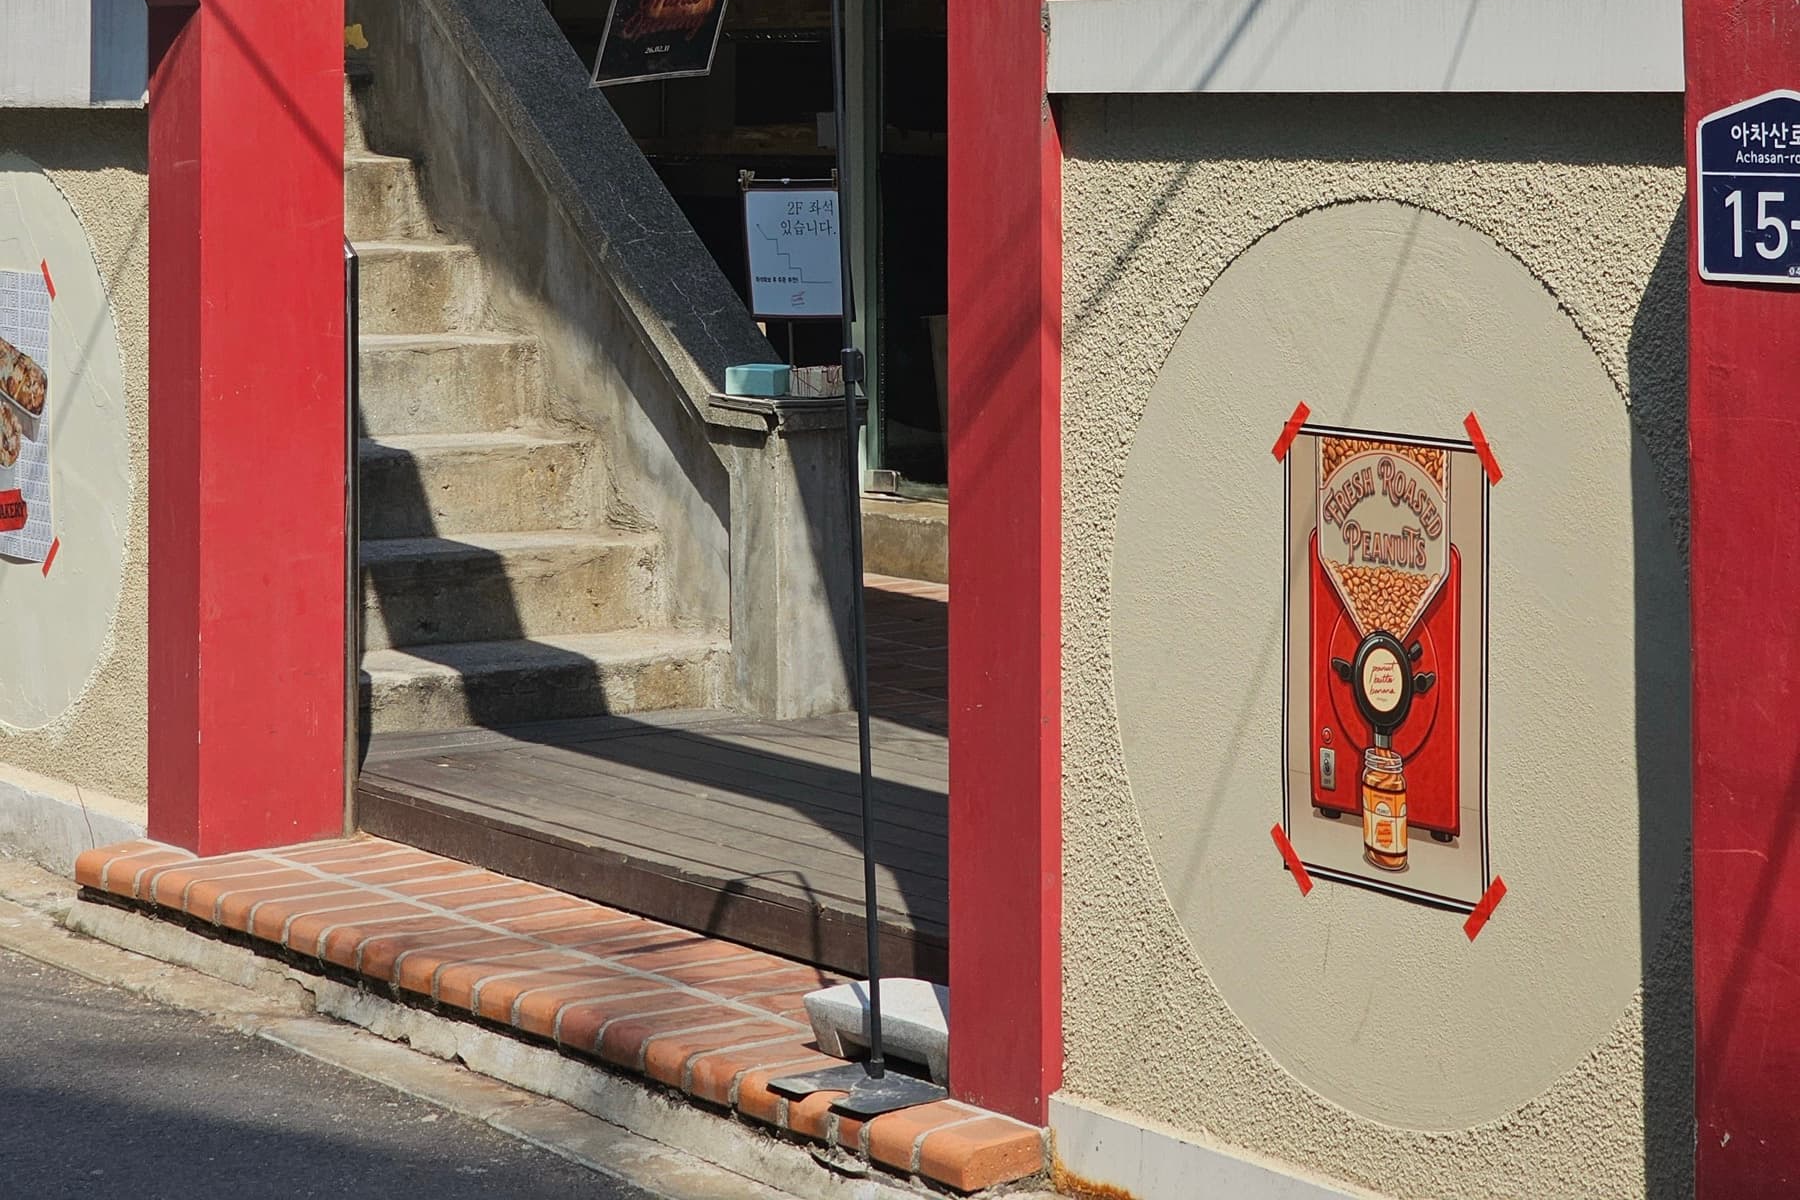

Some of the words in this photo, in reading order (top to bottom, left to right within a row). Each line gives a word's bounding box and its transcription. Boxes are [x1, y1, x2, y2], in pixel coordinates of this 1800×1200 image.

[787, 202, 803, 215] 2F
[809, 200, 834, 216] 좌석
[781, 220, 837, 237] 있습니다.
[1323, 466, 1376, 530] FRESH
[1343, 520, 1428, 570] PEANUTS
